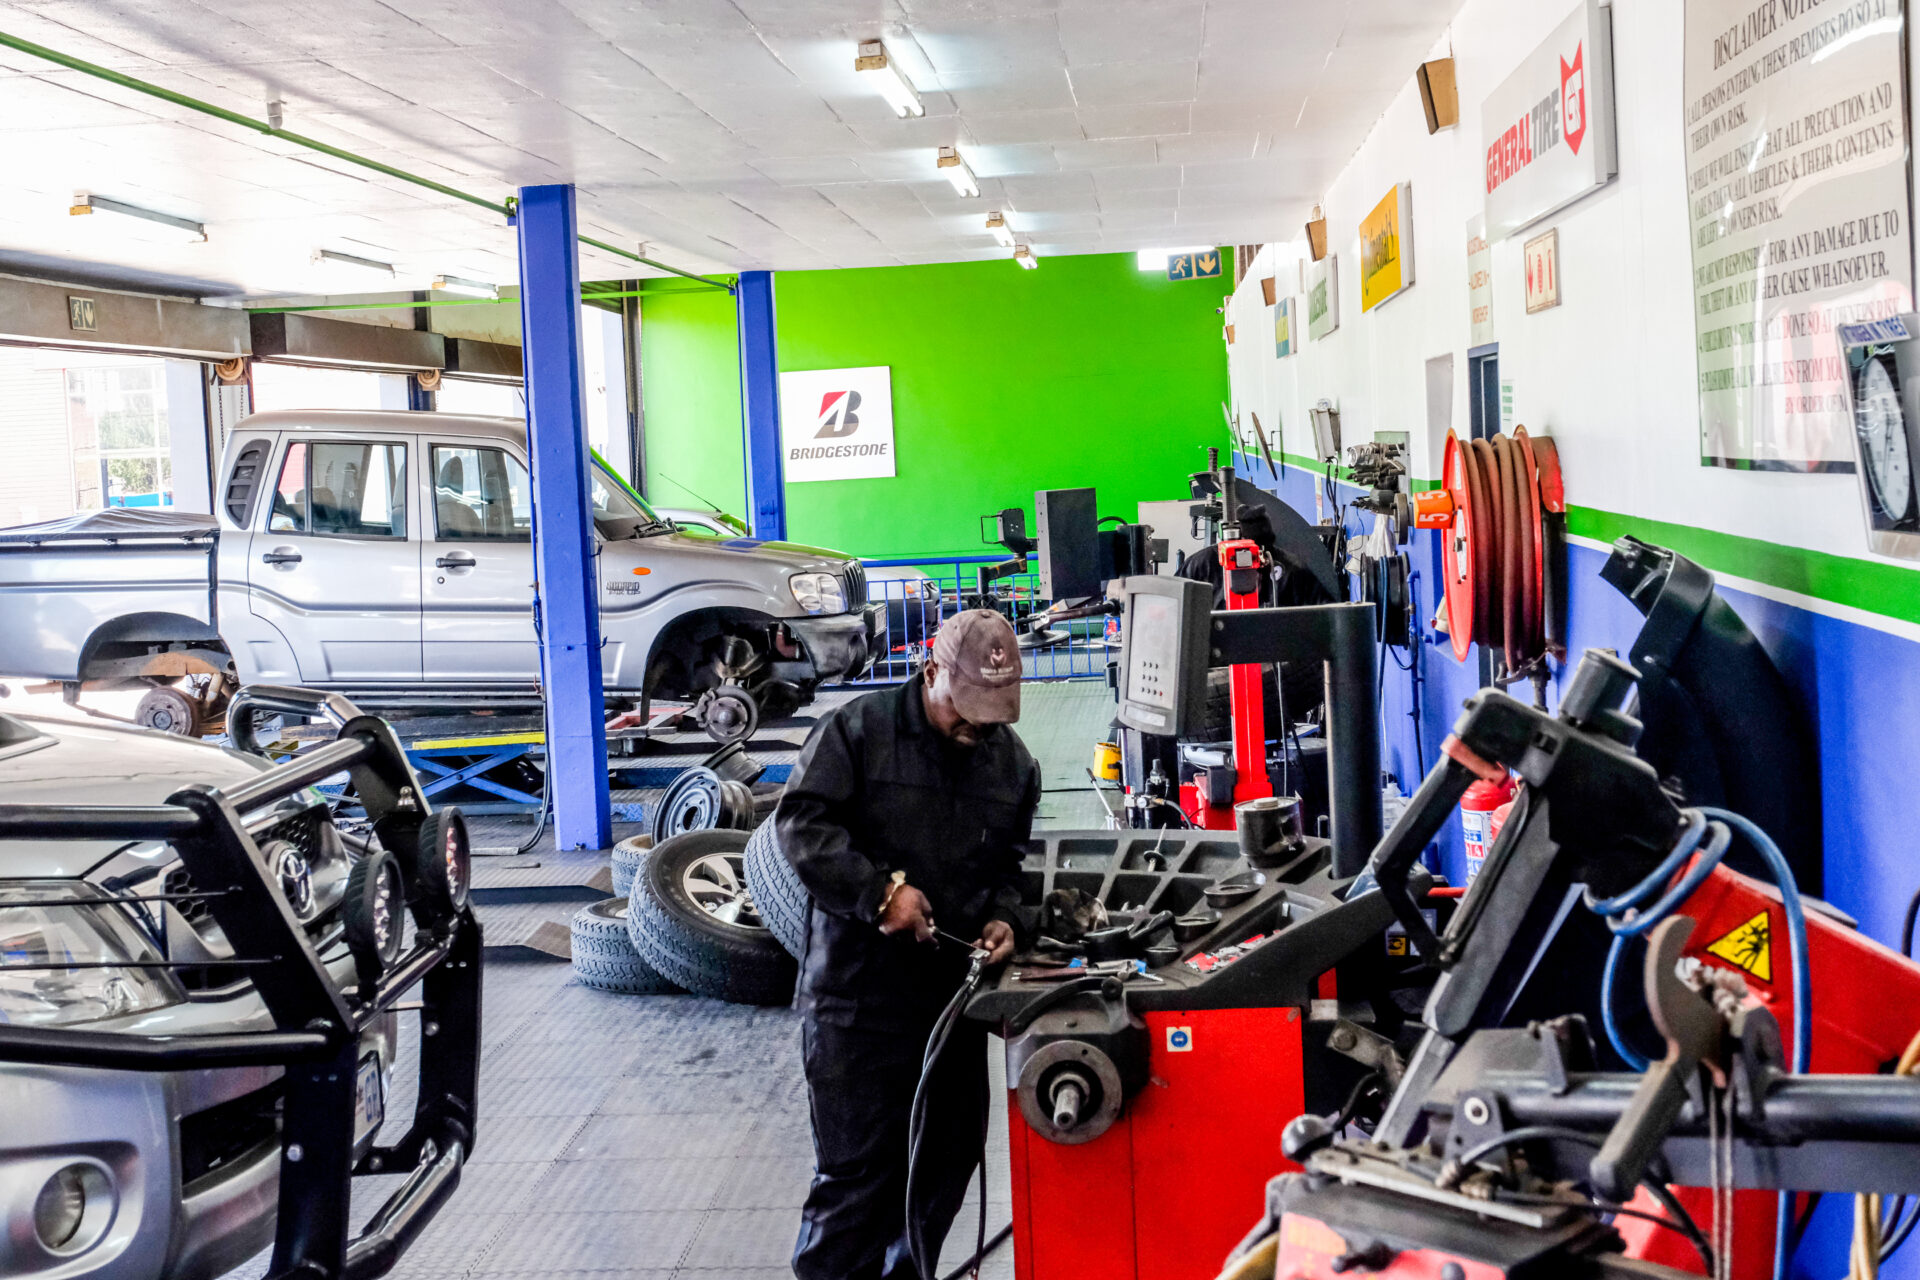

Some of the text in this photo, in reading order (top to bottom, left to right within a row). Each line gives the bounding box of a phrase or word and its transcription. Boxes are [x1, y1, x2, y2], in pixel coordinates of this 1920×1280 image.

[1713, 0, 1777, 71] DISCLAIMER
[1701, 85, 1726, 115] PERSONS
[1725, 62, 1761, 99] ENTERING
[1762, 45, 1787, 77] THESE
[1788, 16, 1837, 63] PREMISES
[1838, 7, 1854, 36] DO
[1855, 0, 1870, 27] SO
[1783, 120, 1802, 148] ALL
[1804, 91, 1865, 141] PRECAUTION
[1866, 80, 1892, 115] AND
[1690, 126, 1709, 151] THEIR
[1748, 160, 1790, 194] VEHICLES
[1790, 156, 1799, 179] &
[1799, 142, 1834, 177] THEIR
[1834, 118, 1895, 165] CONTENTS
[1757, 196, 1783, 223] RISK.
[1769, 239, 1787, 263] FOR
[1789, 233, 1811, 260] ANY
[1813, 220, 1857, 254] DAMAGE
[1858, 215, 1881, 243] DUE
[1882, 209, 1899, 237] TO
[1780, 268, 1810, 295] CAUSE
[1811, 251, 1889, 288] WHATSOEVER.
[1782, 313, 1807, 337] DONE
[1795, 359, 1823, 381] FROM
[1796, 396, 1824, 411] ORDER
[790, 443, 888, 460] BRIDGESTONE
